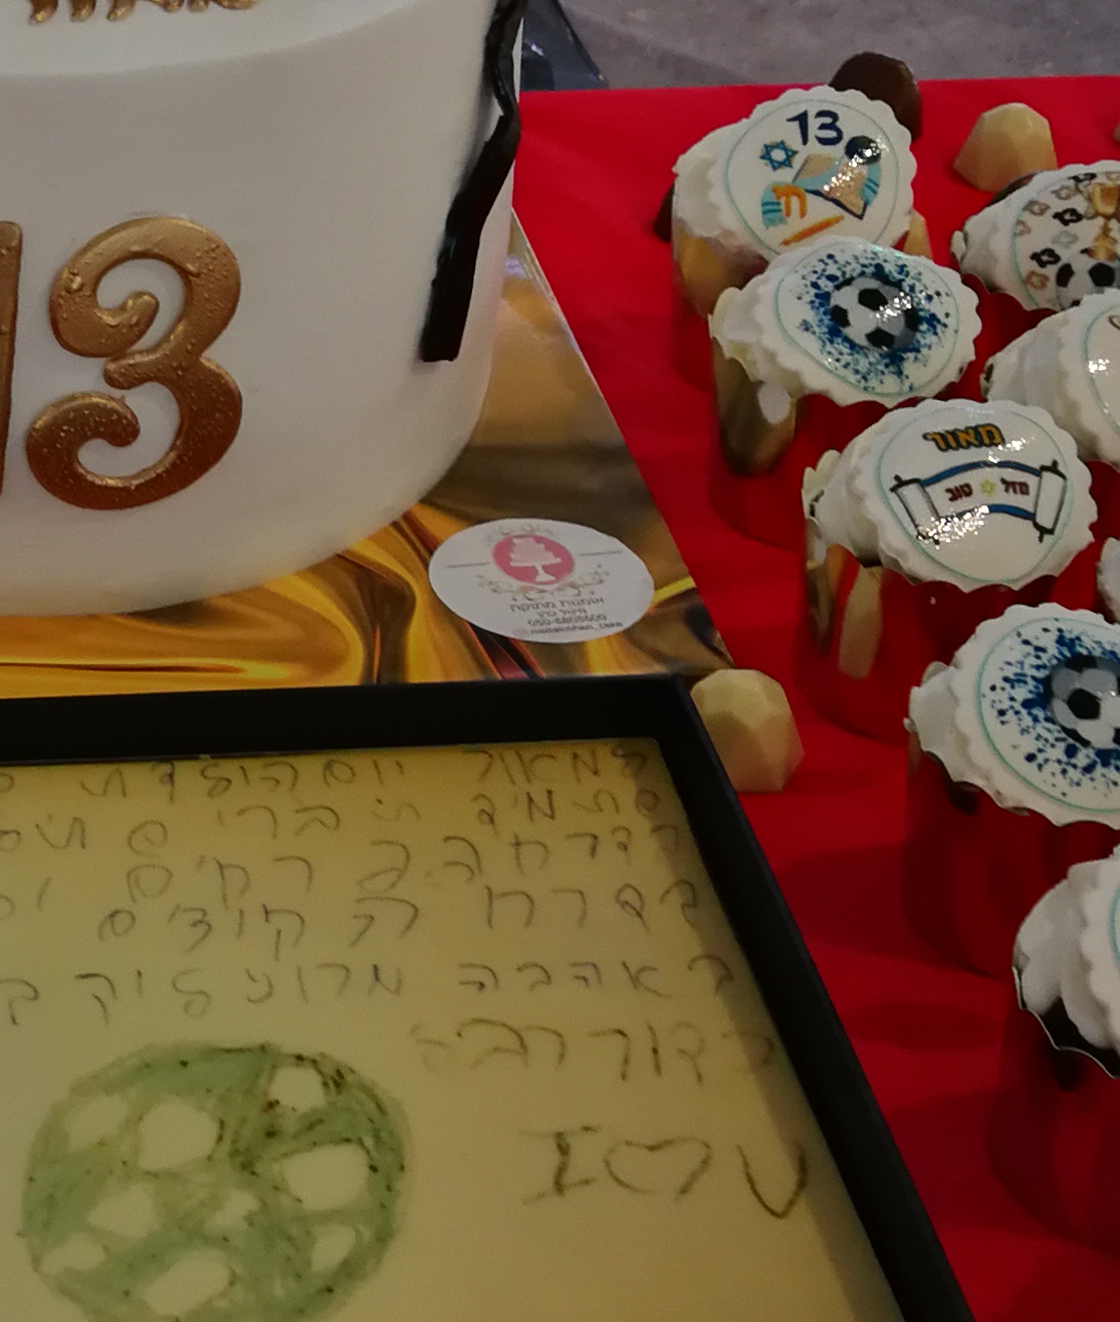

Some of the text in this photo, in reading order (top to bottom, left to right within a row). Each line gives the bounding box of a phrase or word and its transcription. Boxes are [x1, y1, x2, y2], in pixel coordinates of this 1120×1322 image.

[786, 110, 843, 146] 13
[922, 423, 1006, 452] מאור
[945, 477, 1030, 502] מזל טוב
[518, 1126, 603, 1204] I
